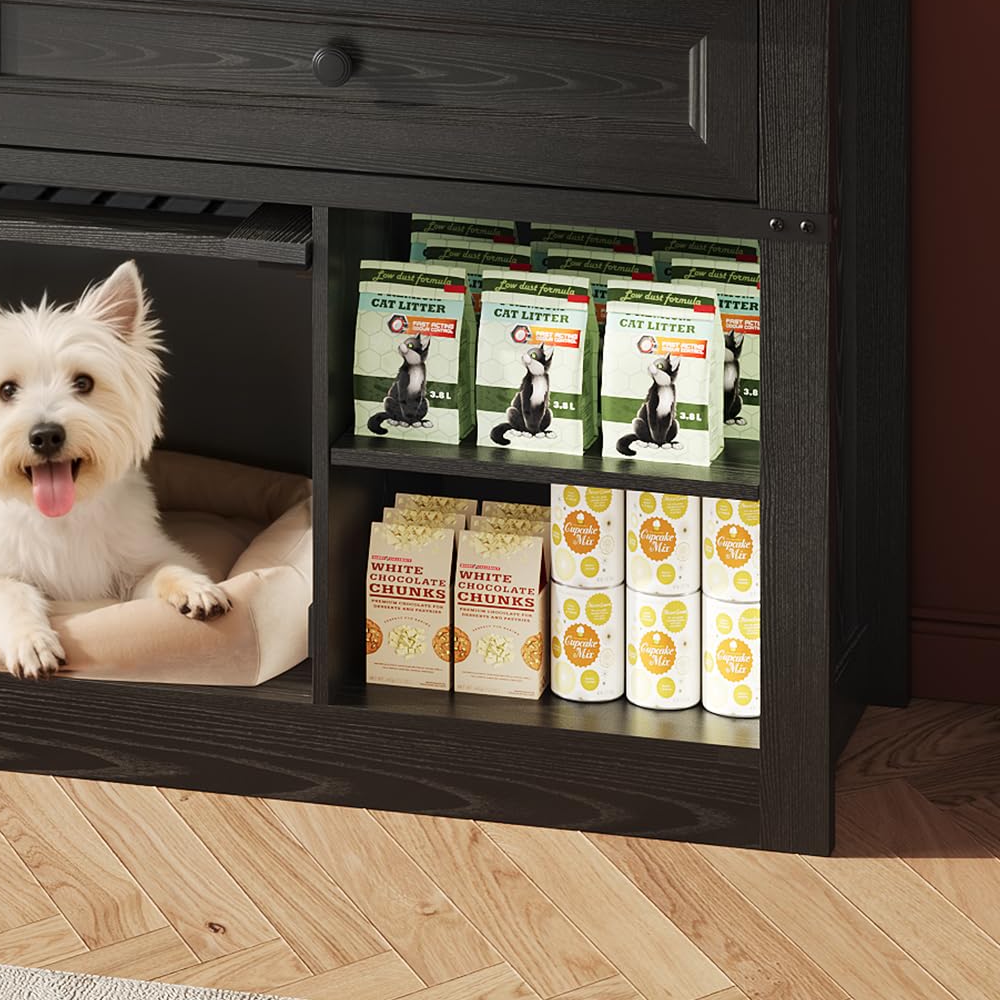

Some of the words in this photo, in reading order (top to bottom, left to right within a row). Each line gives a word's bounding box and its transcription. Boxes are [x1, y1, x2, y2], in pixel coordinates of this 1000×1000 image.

[439, 249, 459, 259] Low
[462, 250, 480, 260] dust
[482, 253, 517, 263] formula
[560, 258, 582, 268] Low
[584, 260, 601, 269] dust
[602, 262, 639, 273] formula
[372, 271, 395, 281] Low
[396, 272, 415, 281] dust
[414, 275, 452, 286] formula
[684, 268, 706, 279] Low
[708, 270, 727, 279] dust
[726, 272, 760, 282] formul
[495, 280, 518, 292] Low
[519, 282, 538, 291] dust
[537, 284, 575, 296] formula
[620, 290, 644, 302] Low
[645, 292, 663, 301] dust
[663, 294, 701, 305] formula
[371, 298, 396, 308] CAT
[398, 301, 446, 313] LITTER
[719, 300, 758, 311] ITTER
[494, 308, 518, 318] CAT
[521, 310, 569, 323] LITTER
[619, 319, 645, 329] CAT
[647, 321, 696, 333] LITTER
[429, 391, 444, 399] 3.8
[743, 388, 758, 396] 3.8
[553, 401, 569, 410] 3.8
[680, 412, 695, 420] 3.8
[696, 413, 702, 421] L
[564, 522, 598, 536] Cupcake
[640, 529, 674, 542] Cupcake
[573, 534, 595, 547] Mix
[649, 541, 670, 553] Mix
[716, 536, 751, 549] Cupcake
[726, 548, 747, 560] Mix
[371, 562, 423, 575] WHITE
[370, 573, 446, 587] CHOCOLATE
[460, 571, 512, 583] WHITE
[369, 583, 445, 599] CHUNKS
[458, 582, 535, 595] CHOCOLATE
[457, 592, 535, 607] CHUNKS
[564, 635, 598, 649] Cupcake
[573, 648, 595, 659] Mix
[640, 642, 675, 656] Cupcake
[649, 655, 670, 667] Mix
[716, 649, 751, 663] Cupcake
[726, 662, 747, 674] Mix
